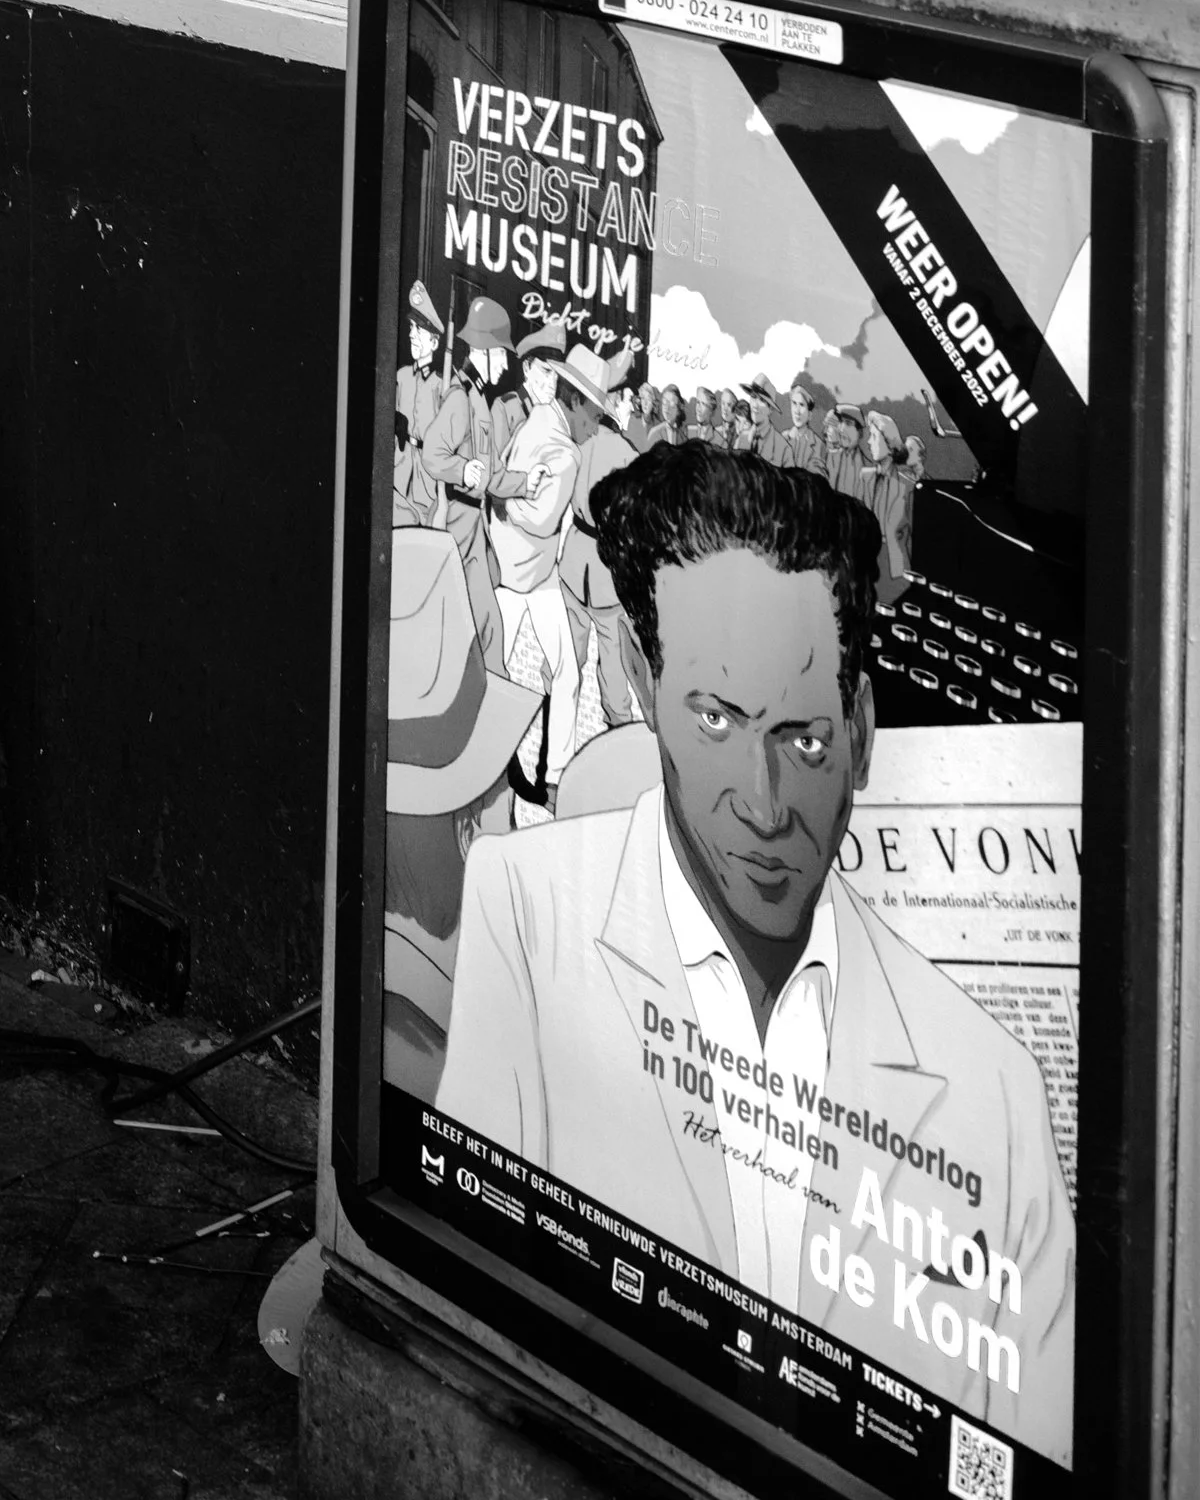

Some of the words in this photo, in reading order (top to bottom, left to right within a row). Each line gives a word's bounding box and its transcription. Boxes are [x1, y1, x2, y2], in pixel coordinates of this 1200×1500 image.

[685, 18, 769, 44] www.centercom.nl
[689, 0, 719, 20] 024
[724, 6, 743, 25] 24
[750, 12, 768, 31] 10
[781, 17, 828, 36] VERBODEN
[781, 29, 799, 40] AAN
[802, 32, 813, 43] TE
[781, 38, 821, 55] PLAKKEN
[453, 77, 646, 178] VERZETS
[446, 139, 721, 268] RESISTANCE
[444, 203, 638, 314] MUSEUM
[876, 183, 958, 309] WEER
[946, 302, 1039, 431] OPEN!
[521, 292, 591, 335] Dicht
[588, 321, 617, 354] op
[621, 325, 644, 355] je
[646, 331, 711, 371] huid
[882, 242, 915, 287] VANAF
[909, 287, 921, 300] 2
[916, 298, 966, 372] DECEMBER
[961, 369, 989, 407] 2022
[838, 827, 907, 873] DE
[882, 890, 898, 907] de
[904, 890, 1078, 911] Internationaal-Socialistische
[1027, 929, 1042, 942] DE
[1045, 930, 1073, 942] VONK
[643, 999, 675, 1043] De
[681, 1018, 784, 1098] Tweede
[791, 1072, 983, 1208] Wereldoorlog
[643, 1040, 666, 1081] in
[672, 1056, 714, 1104] 100
[722, 1088, 840, 1171] verhalen
[682, 1109, 722, 1144] Het
[721, 1141, 797, 1190] verhaal
[801, 1184, 842, 1215] van
[422, 1111, 464, 1145] BELEEF
[466, 1136, 488, 1160] HET
[491, 1150, 503, 1169] IN
[505, 1158, 528, 1183] HET
[531, 1173, 576, 1212] GEHEEL
[578, 1199, 657, 1259] VERNIEUWDE
[659, 1247, 769, 1323] VERZETSMUSEUM
[771, 1312, 853, 1371] AMSTERDAM
[862, 1362, 923, 1412] TICKETS
[850, 1165, 1023, 1316] Anton
[809, 1223, 876, 1309] de
[893, 1257, 1022, 1395] Kom
